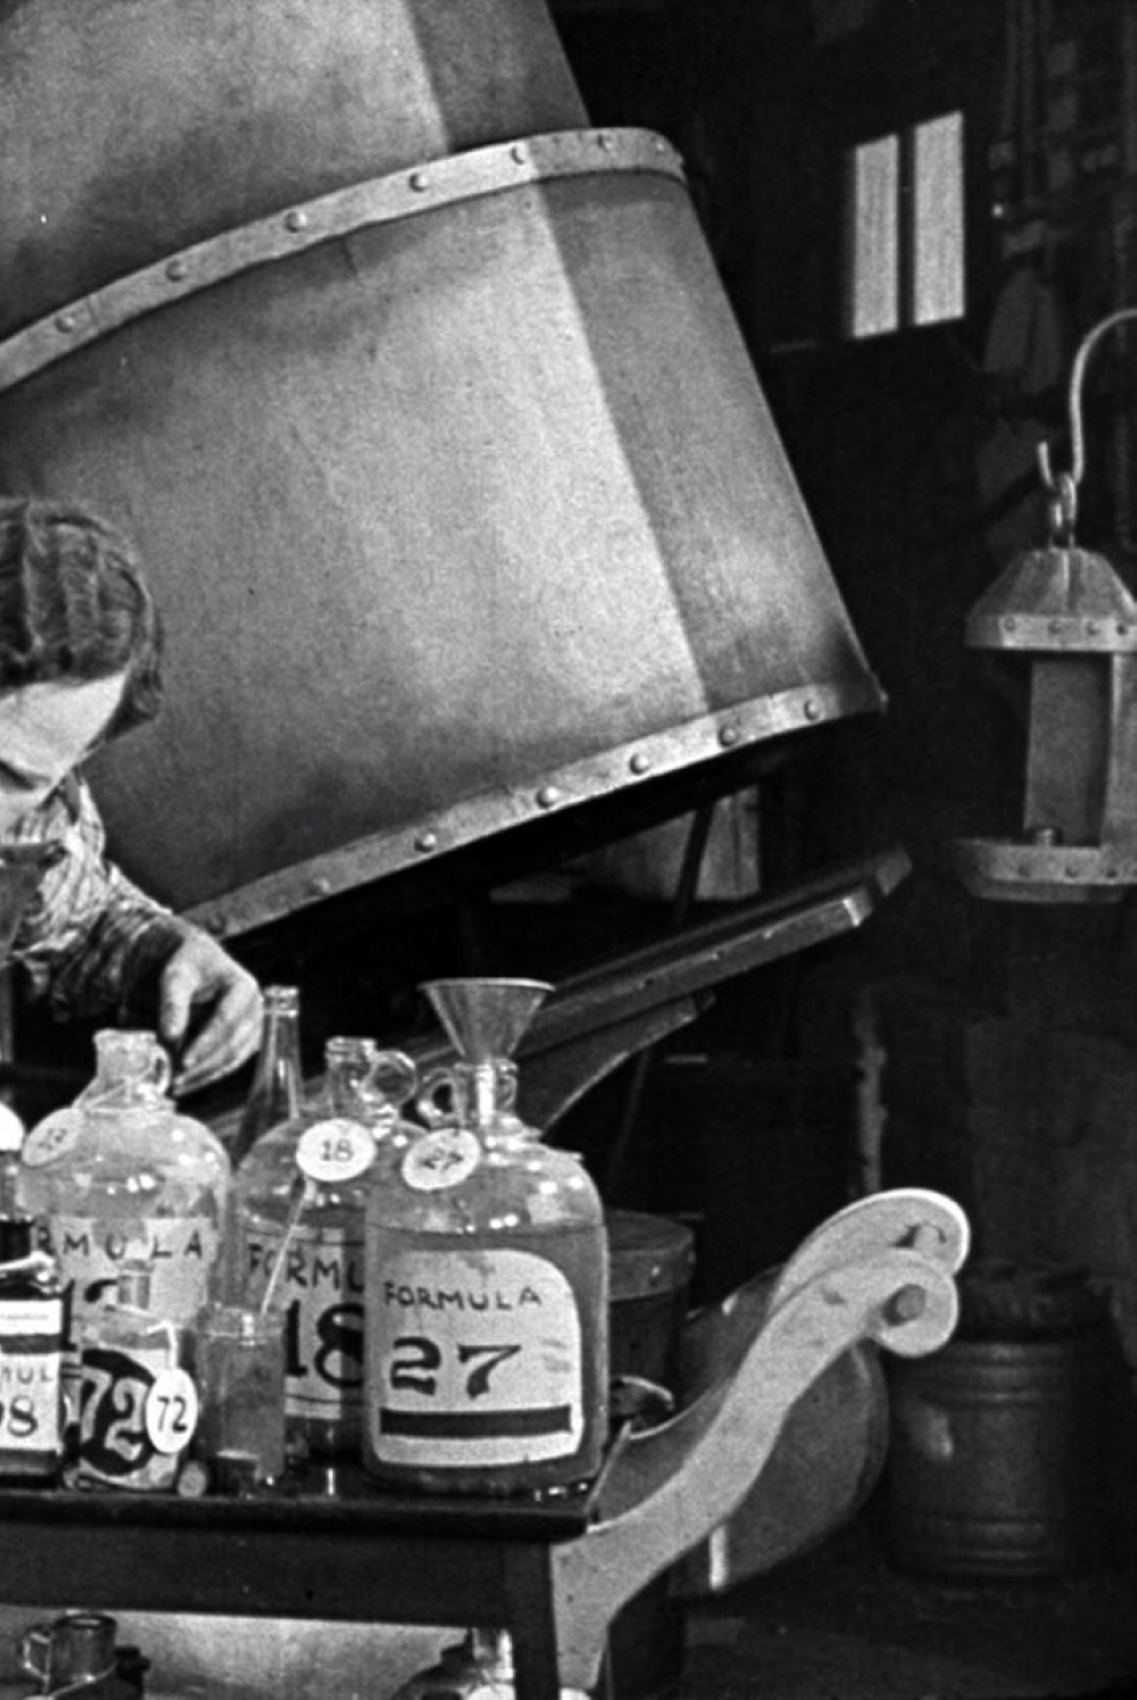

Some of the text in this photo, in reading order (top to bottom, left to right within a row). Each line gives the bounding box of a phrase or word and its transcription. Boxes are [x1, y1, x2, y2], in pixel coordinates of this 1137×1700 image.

[321, 1138, 356, 1163] 18
[382, 1281, 543, 1311] FORMULA
[284, 1298, 365, 1389] 18
[388, 1335, 523, 1399] 27
[157, 1394, 188, 1433] 72
